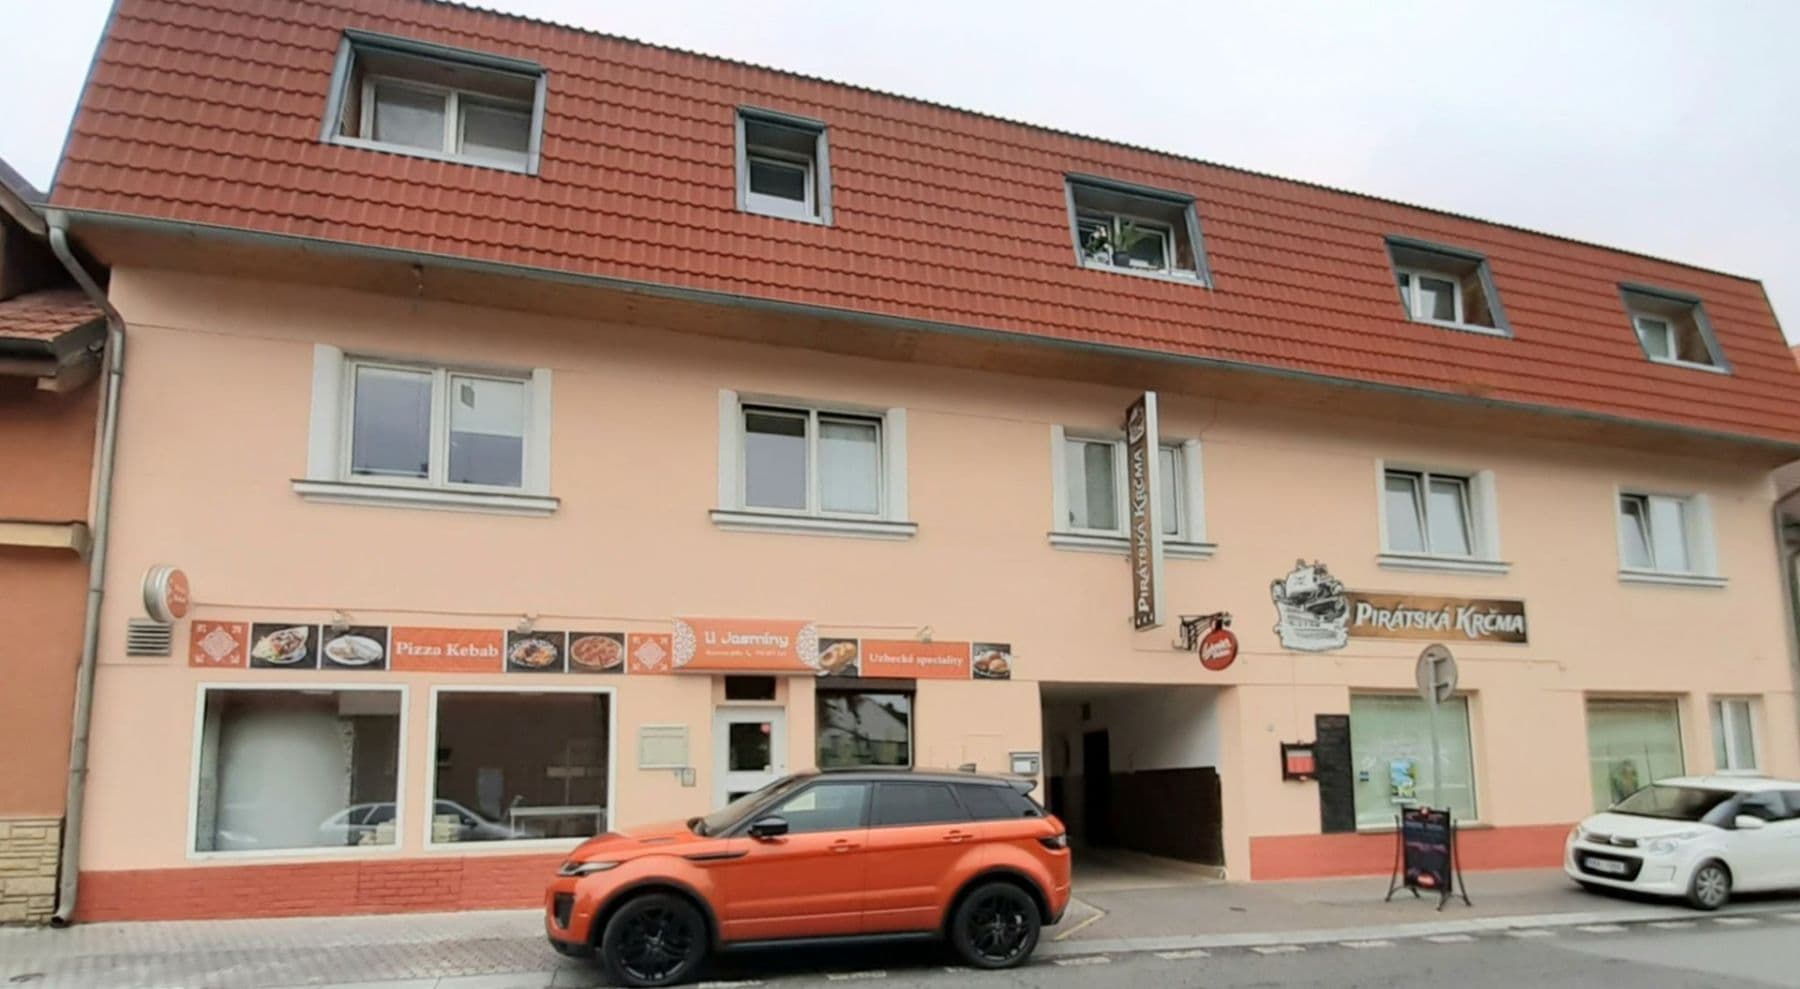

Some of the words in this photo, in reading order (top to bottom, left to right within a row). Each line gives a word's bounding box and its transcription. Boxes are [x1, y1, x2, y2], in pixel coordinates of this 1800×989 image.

[1135, 523, 1150, 613] PIRÁTSKÁ
[1354, 602, 1450, 632] PIRÁTSKÁ
[1456, 606, 1524, 639] KRČMA
[395, 641, 441, 656] Pizza
[446, 643, 499, 657] Kebab
